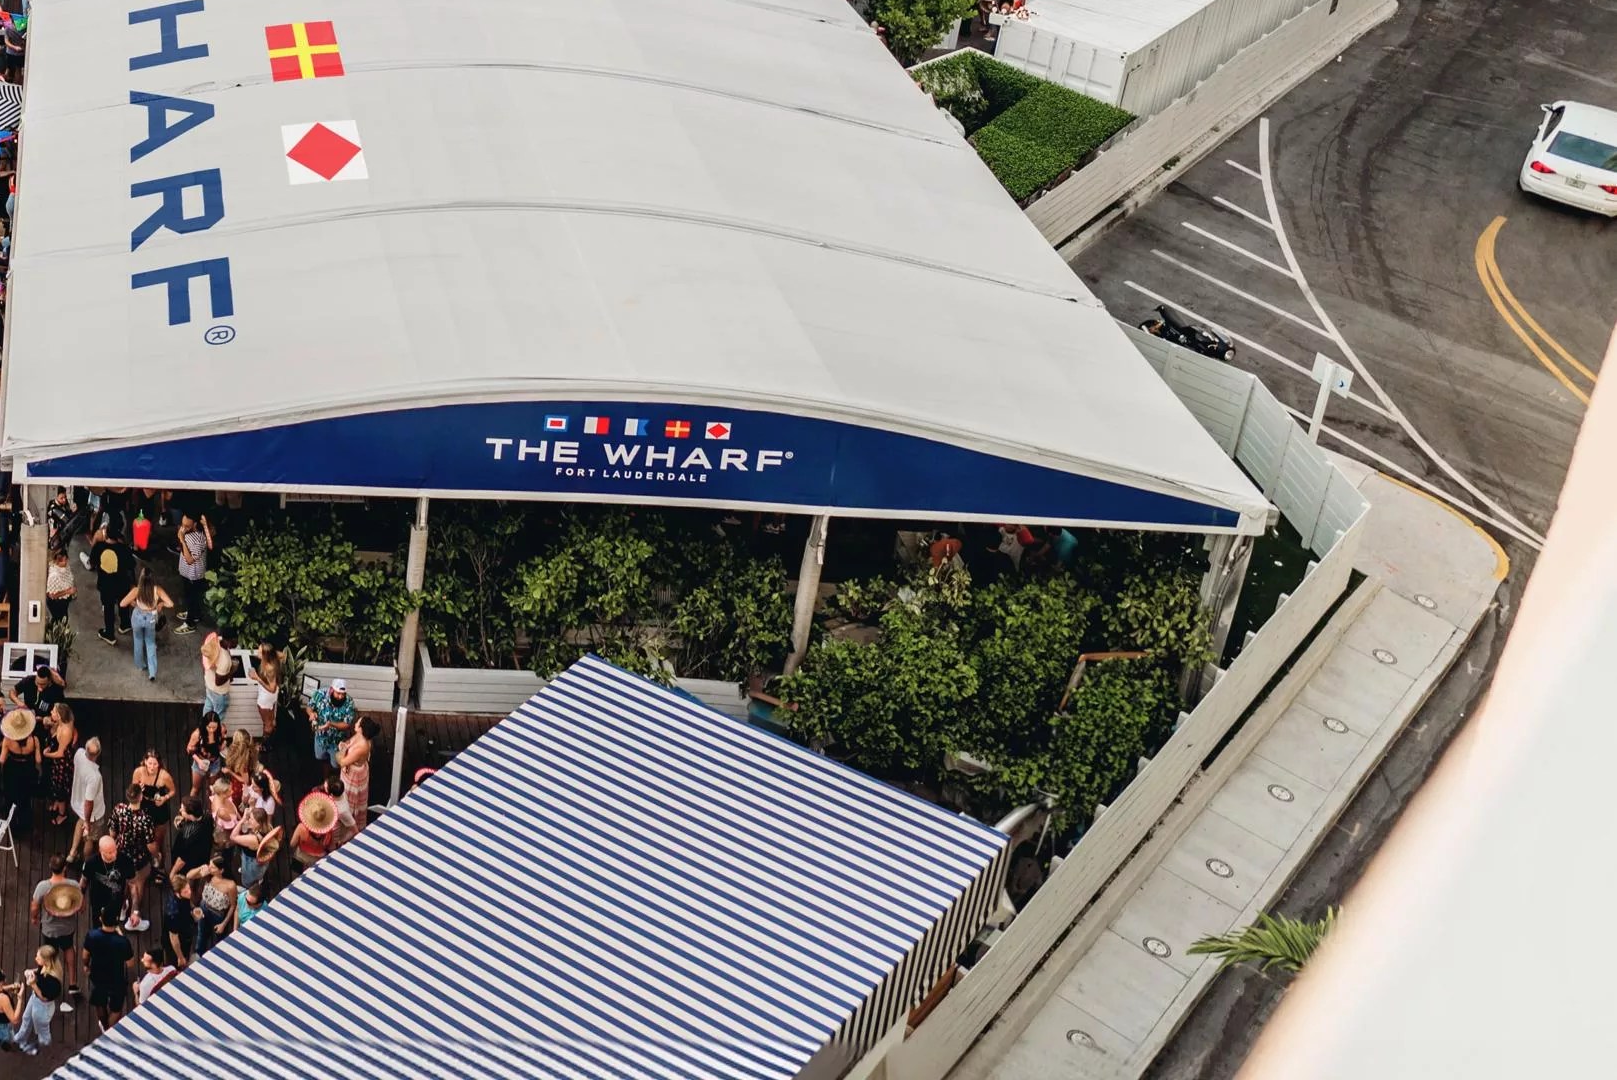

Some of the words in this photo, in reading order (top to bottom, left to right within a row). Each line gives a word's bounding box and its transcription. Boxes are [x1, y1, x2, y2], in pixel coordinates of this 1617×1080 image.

[485, 437, 580, 463] THE
[555, 467, 596, 477] FORT
[602, 470, 708, 483] LAUDERDALE
